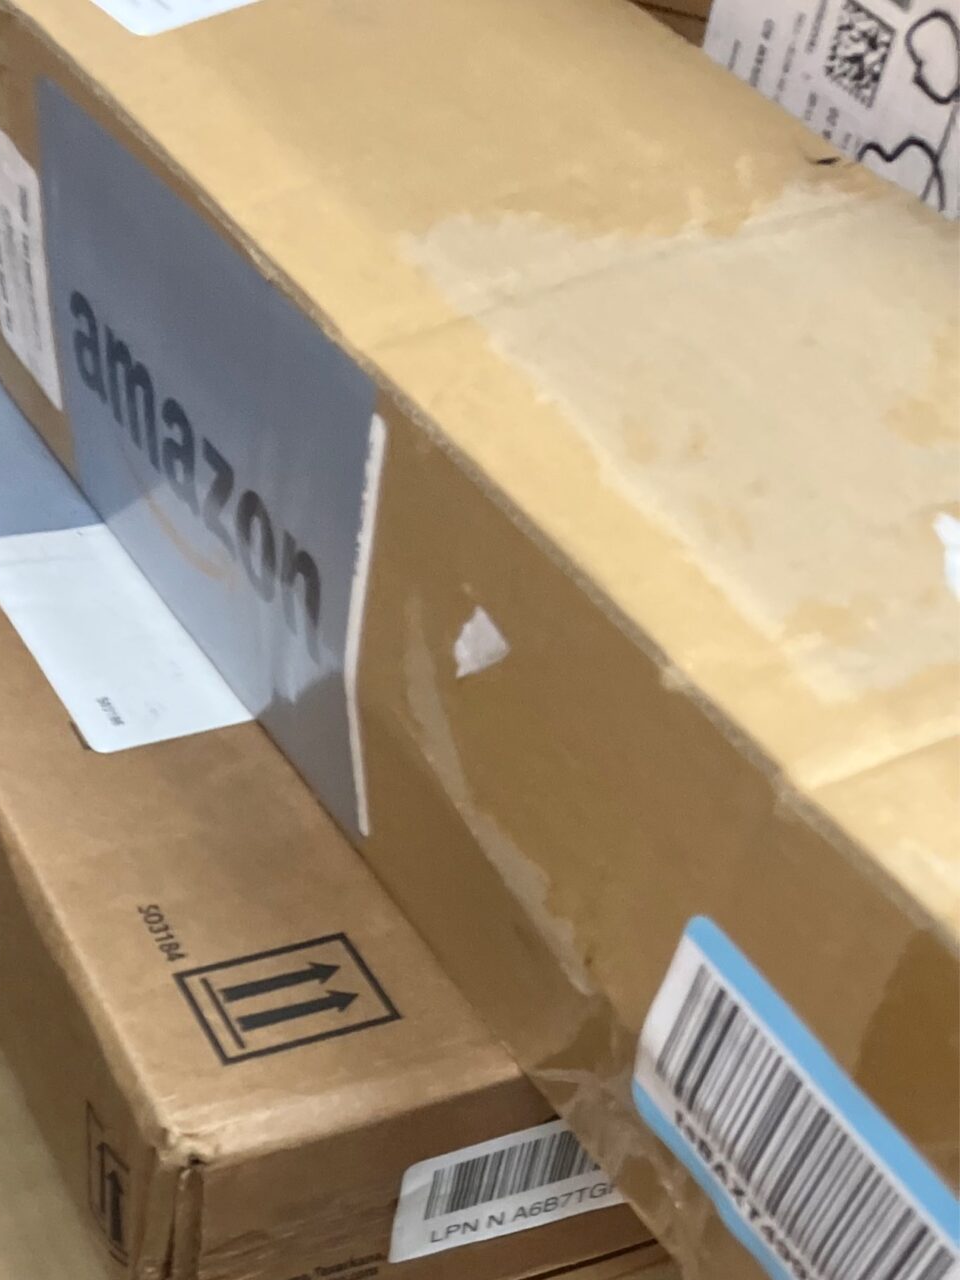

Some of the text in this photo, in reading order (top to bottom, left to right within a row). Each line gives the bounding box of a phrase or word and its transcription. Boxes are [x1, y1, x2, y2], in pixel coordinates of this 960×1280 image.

[69, 289, 321, 666] amazon
[429, 1218, 479, 1243] LPN
[486, 1211, 506, 1229] N
